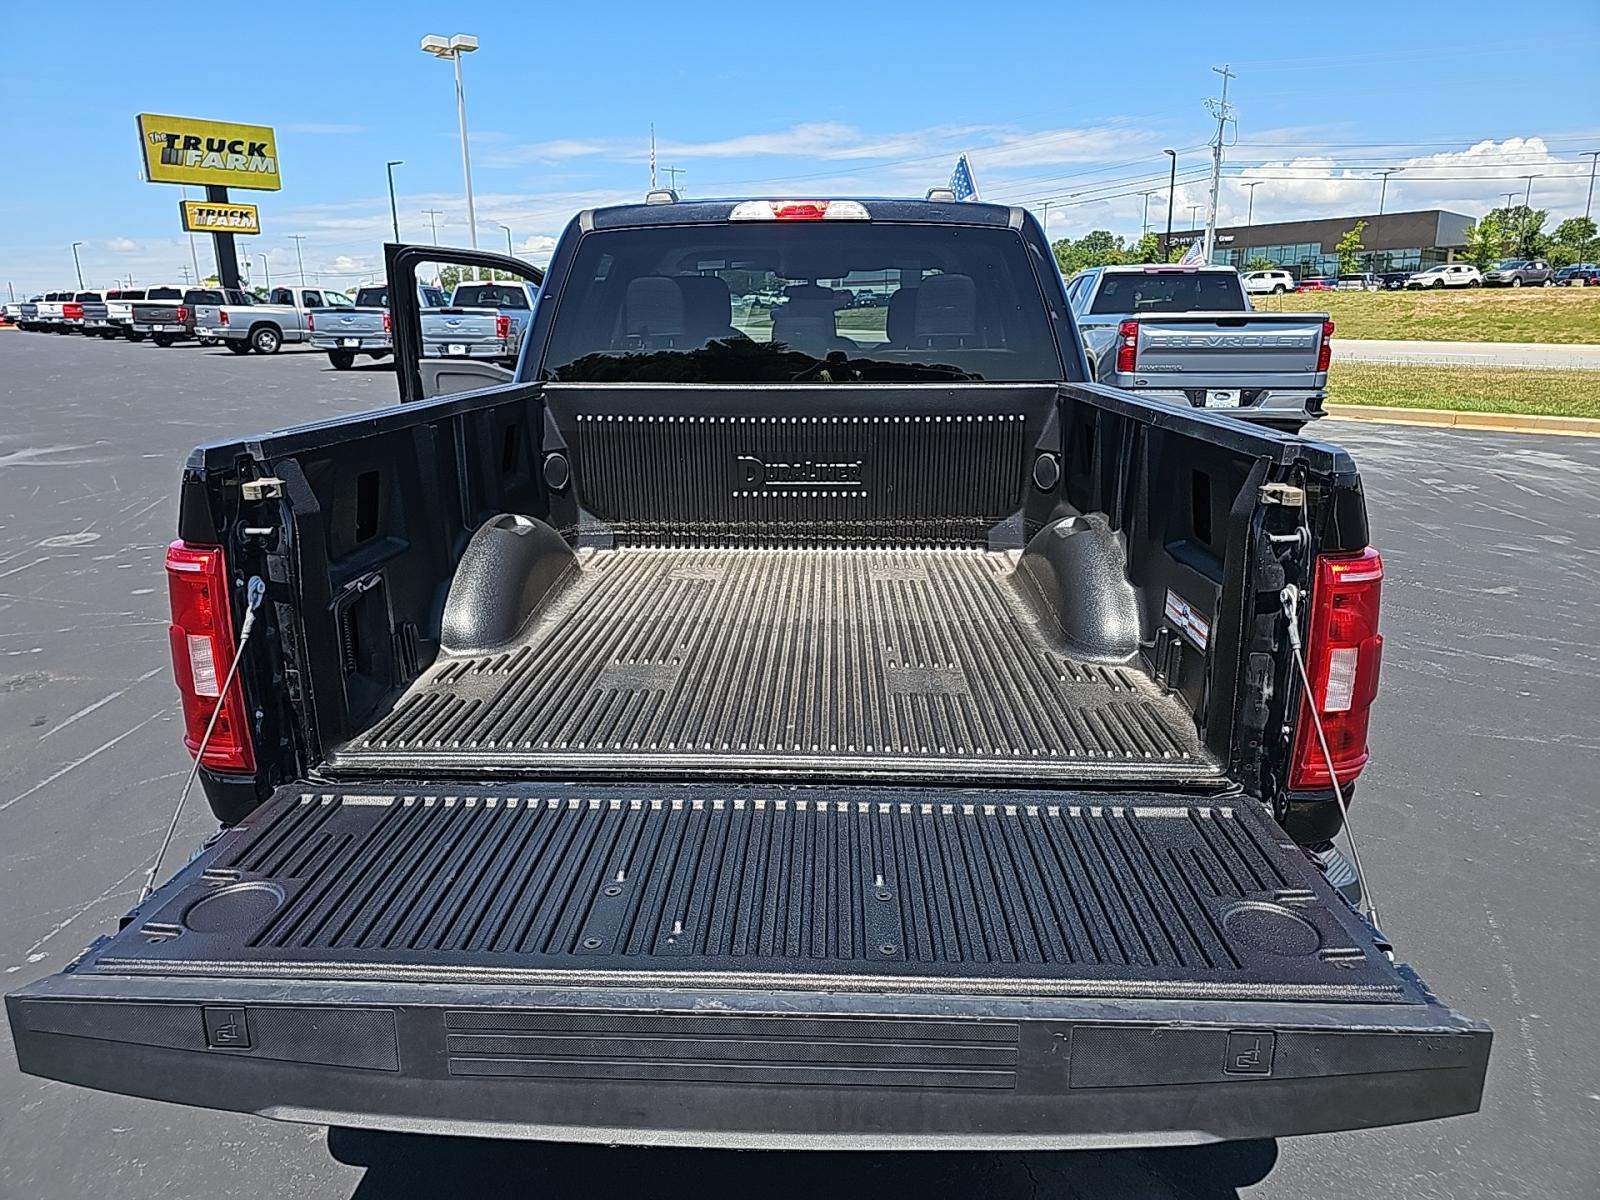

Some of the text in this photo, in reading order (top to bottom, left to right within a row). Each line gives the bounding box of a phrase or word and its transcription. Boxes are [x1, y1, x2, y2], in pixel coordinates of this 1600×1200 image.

[148, 131, 268, 157] The TRUCK
[185, 150, 277, 174] FARM
[196, 208, 253, 218] TRUCK
[207, 215, 257, 229] FARM
[1150, 334, 1314, 348] CHEVROLET
